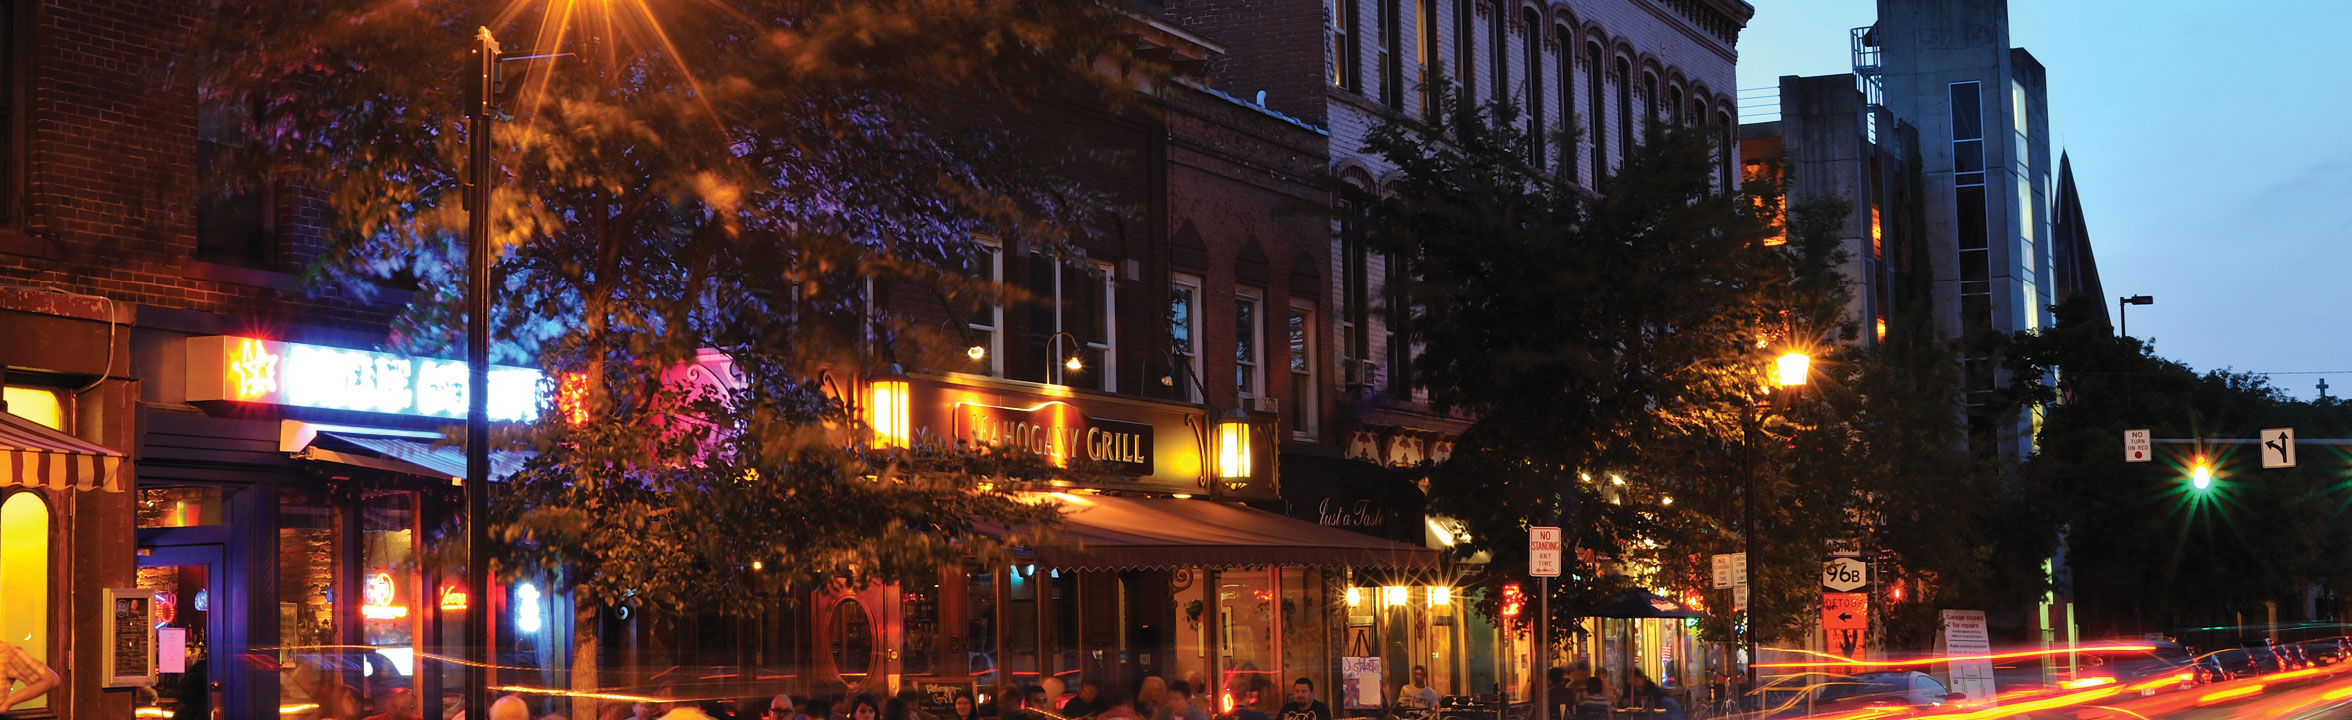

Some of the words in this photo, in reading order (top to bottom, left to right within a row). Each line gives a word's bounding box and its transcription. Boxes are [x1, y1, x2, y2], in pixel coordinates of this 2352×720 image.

[969, 413, 1080, 459] MAHOGANY
[1086, 426, 1145, 464] GRILL
[1343, 513, 1351, 526] a
[1353, 499, 1385, 526] Taste
[1540, 531, 1551, 540] NO
[1531, 542, 1560, 550] STANDING
[1826, 564, 1860, 582] 96B
